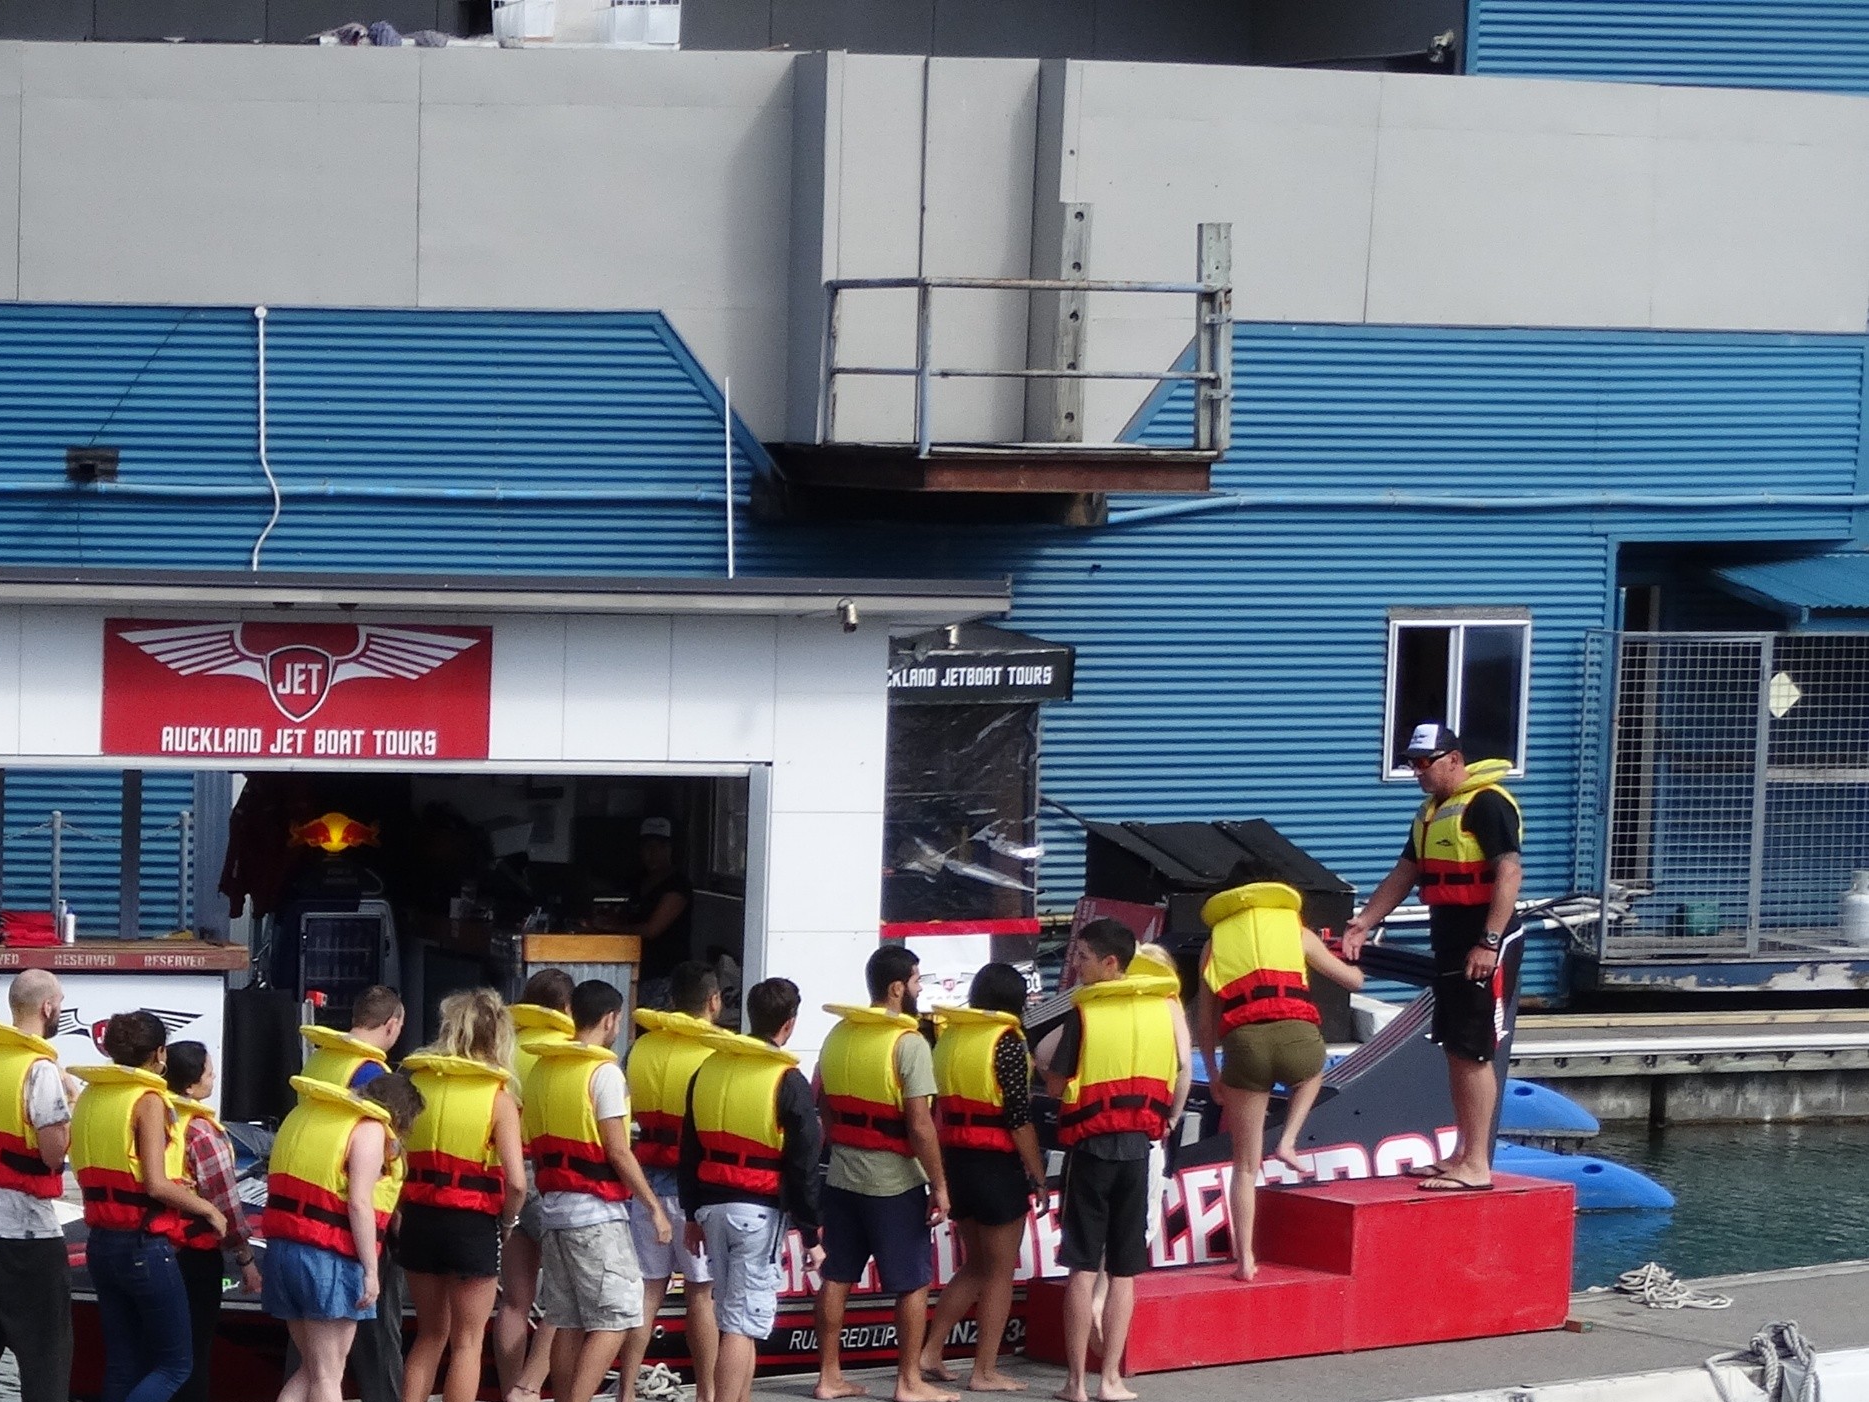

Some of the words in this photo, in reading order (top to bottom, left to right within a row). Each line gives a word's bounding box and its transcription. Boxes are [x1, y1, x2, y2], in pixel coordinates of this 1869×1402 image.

[276, 662, 323, 695] JET
[940, 666, 1004, 687] JETBOAT
[1007, 665, 1054, 686] TOURS
[160, 726, 262, 754] AUCKLAND
[269, 727, 307, 755] JET
[313, 728, 365, 755] BOAT
[372, 729, 438, 756] TOURS
[54, 954, 116, 966] RESERVED
[144, 954, 206, 967] RESERVED
